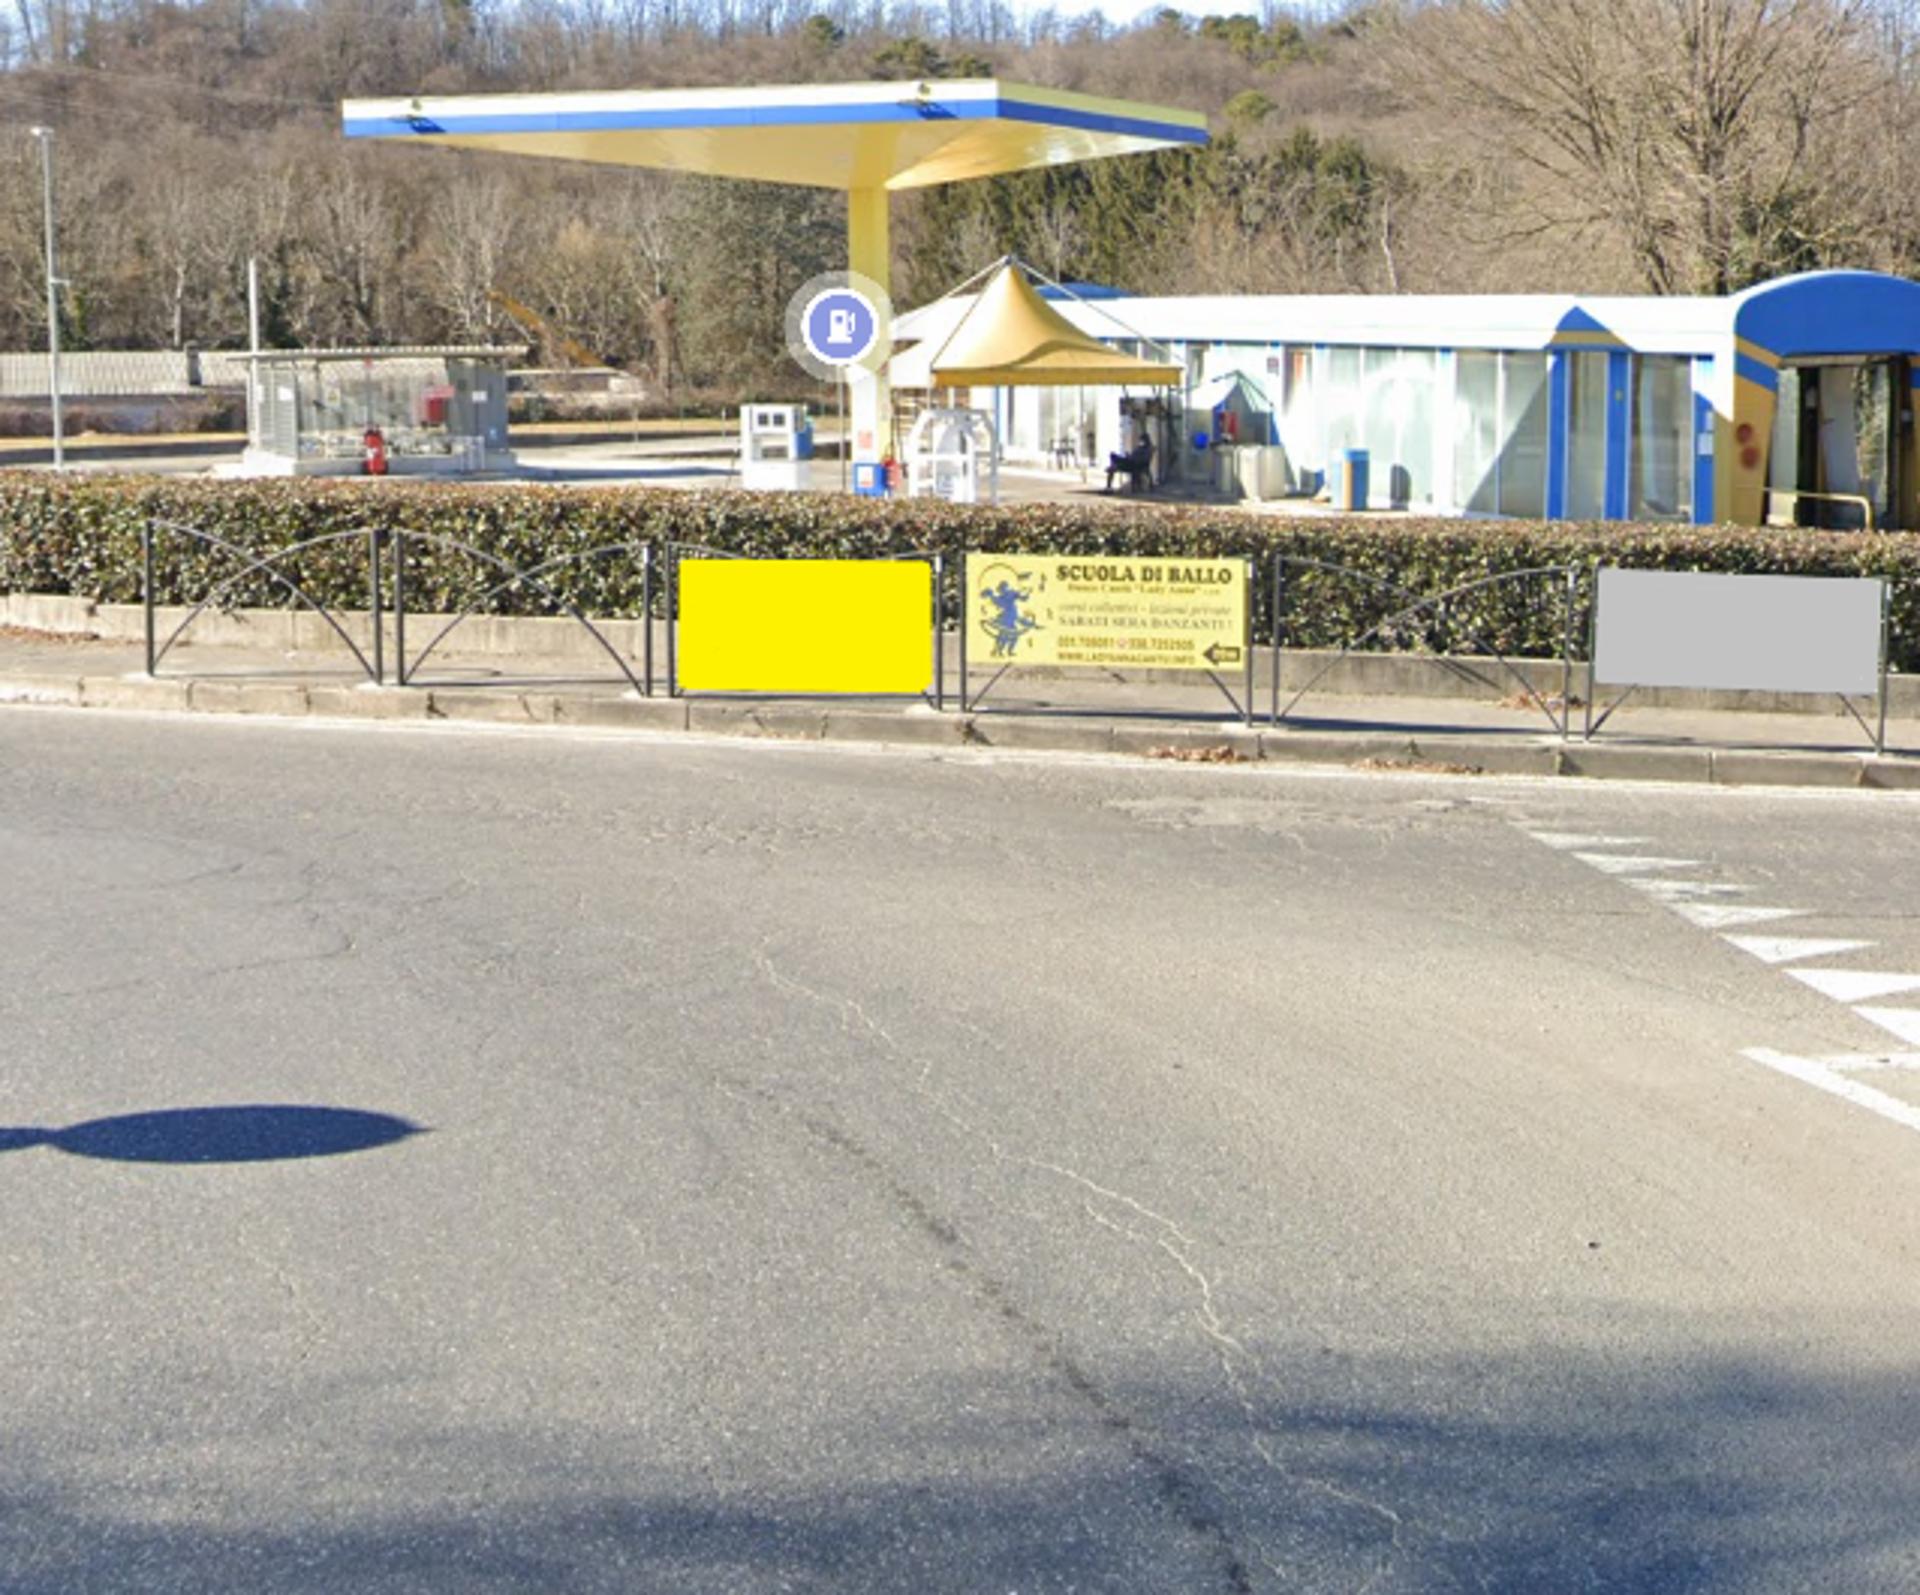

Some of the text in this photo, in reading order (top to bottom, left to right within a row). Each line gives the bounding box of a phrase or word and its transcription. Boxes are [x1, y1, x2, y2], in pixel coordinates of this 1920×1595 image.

[1057, 565, 1232, 585] SCUOLA DI BALLO
[1112, 617, 1147, 628] SERA
